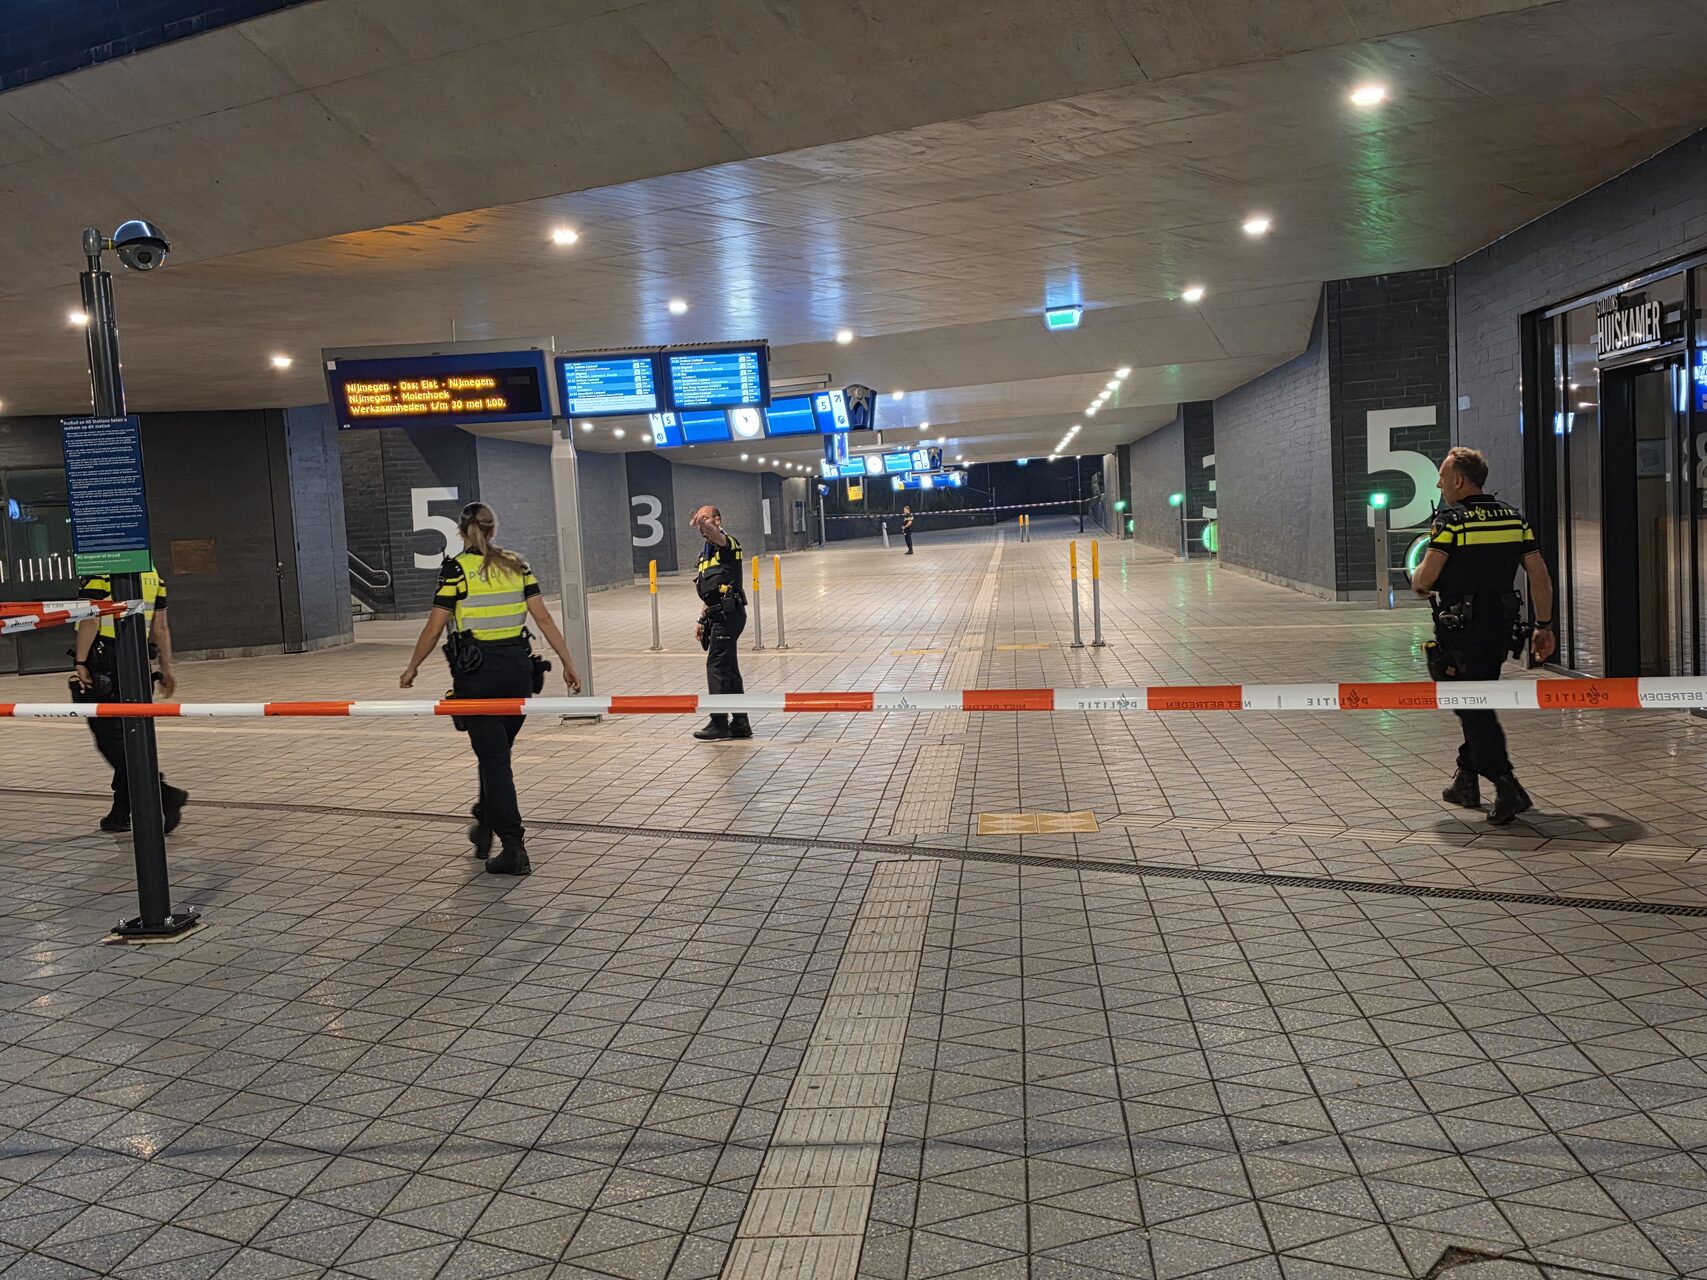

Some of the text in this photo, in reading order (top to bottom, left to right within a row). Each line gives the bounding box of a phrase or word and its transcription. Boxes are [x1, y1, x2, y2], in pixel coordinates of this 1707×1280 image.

[1597, 301, 1661, 353] HUISKAMER
[346, 383, 389, 393] Nijmegen
[421, 380, 438, 389] Elst
[349, 394, 391, 404] Nijmegen
[402, 391, 450, 401] Molenhoek
[431, 401, 448, 410] t/m
[452, 400, 463, 409] 30
[466, 400, 482, 408] mei
[1366, 405, 1441, 529] 5
[410, 486, 463, 569] 5
[631, 494, 664, 547] 3
[1468, 507, 1517, 520] POLITIE
